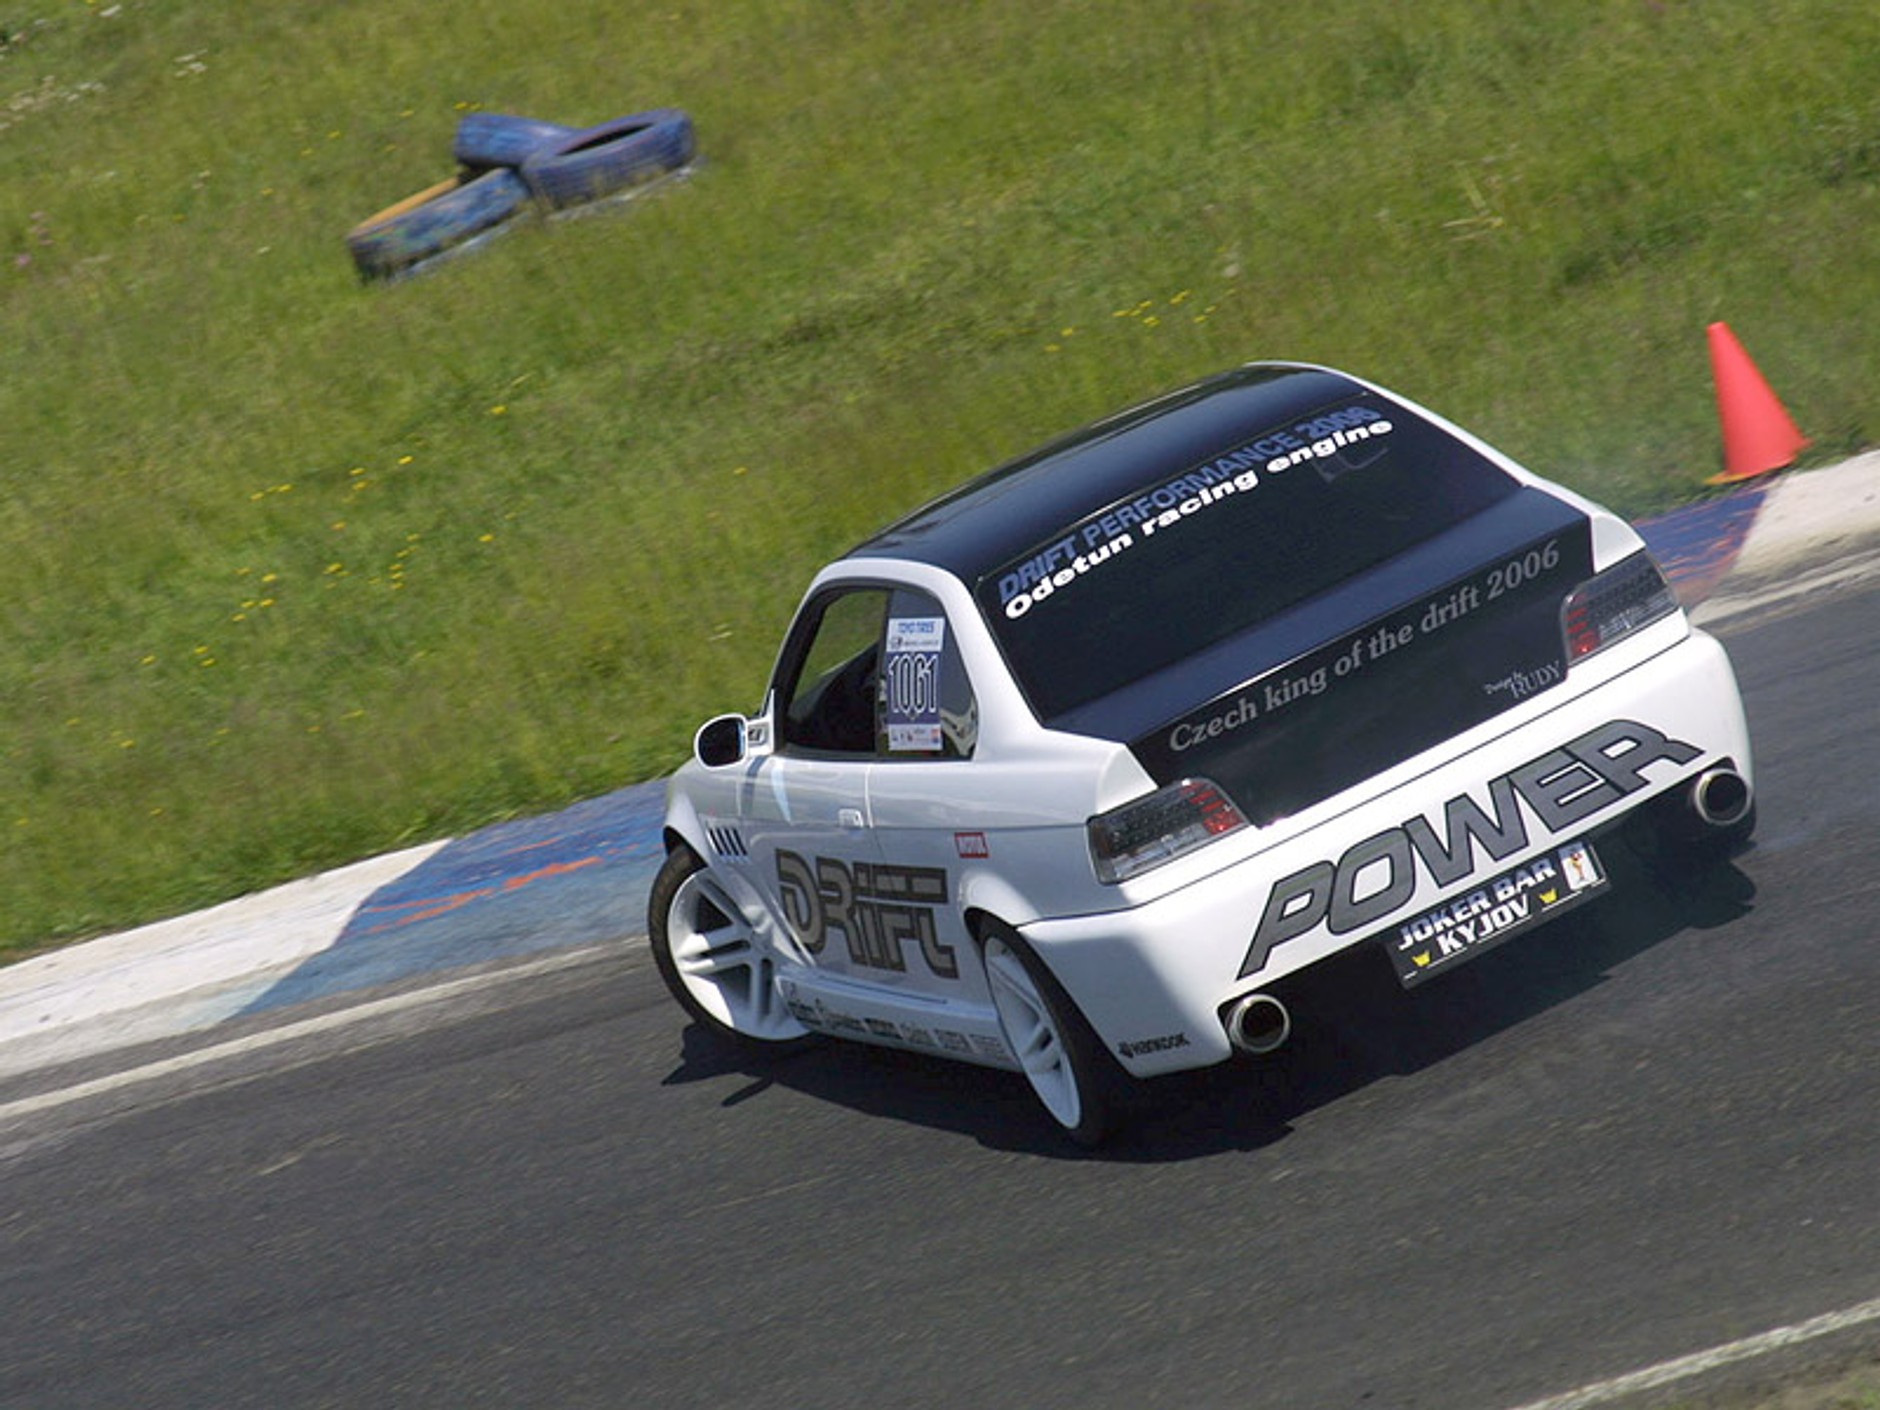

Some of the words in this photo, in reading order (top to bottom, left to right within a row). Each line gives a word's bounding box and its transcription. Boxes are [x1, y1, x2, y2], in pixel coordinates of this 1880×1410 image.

[997, 535, 1077, 603] DRIFT
[1082, 432, 1304, 547] PERFORMANCE
[1005, 533, 1134, 619] Odetun
[1141, 470, 1259, 536] racing
[1266, 420, 1393, 473] engine
[1169, 691, 1259, 752] Czech
[1265, 665, 1327, 711] king
[1334, 640, 1367, 676] of
[1369, 624, 1413, 661] the
[1421, 588, 1481, 633] drift
[1486, 540, 1561, 601] 2006
[1511, 660, 1560, 699] RUDY
[775, 847, 960, 979] DRIFT
[1236, 718, 1707, 981] POWER
[1399, 890, 1492, 951] JOKER
[1492, 858, 1557, 898] BAR
[1436, 893, 1531, 955] KYJOV
